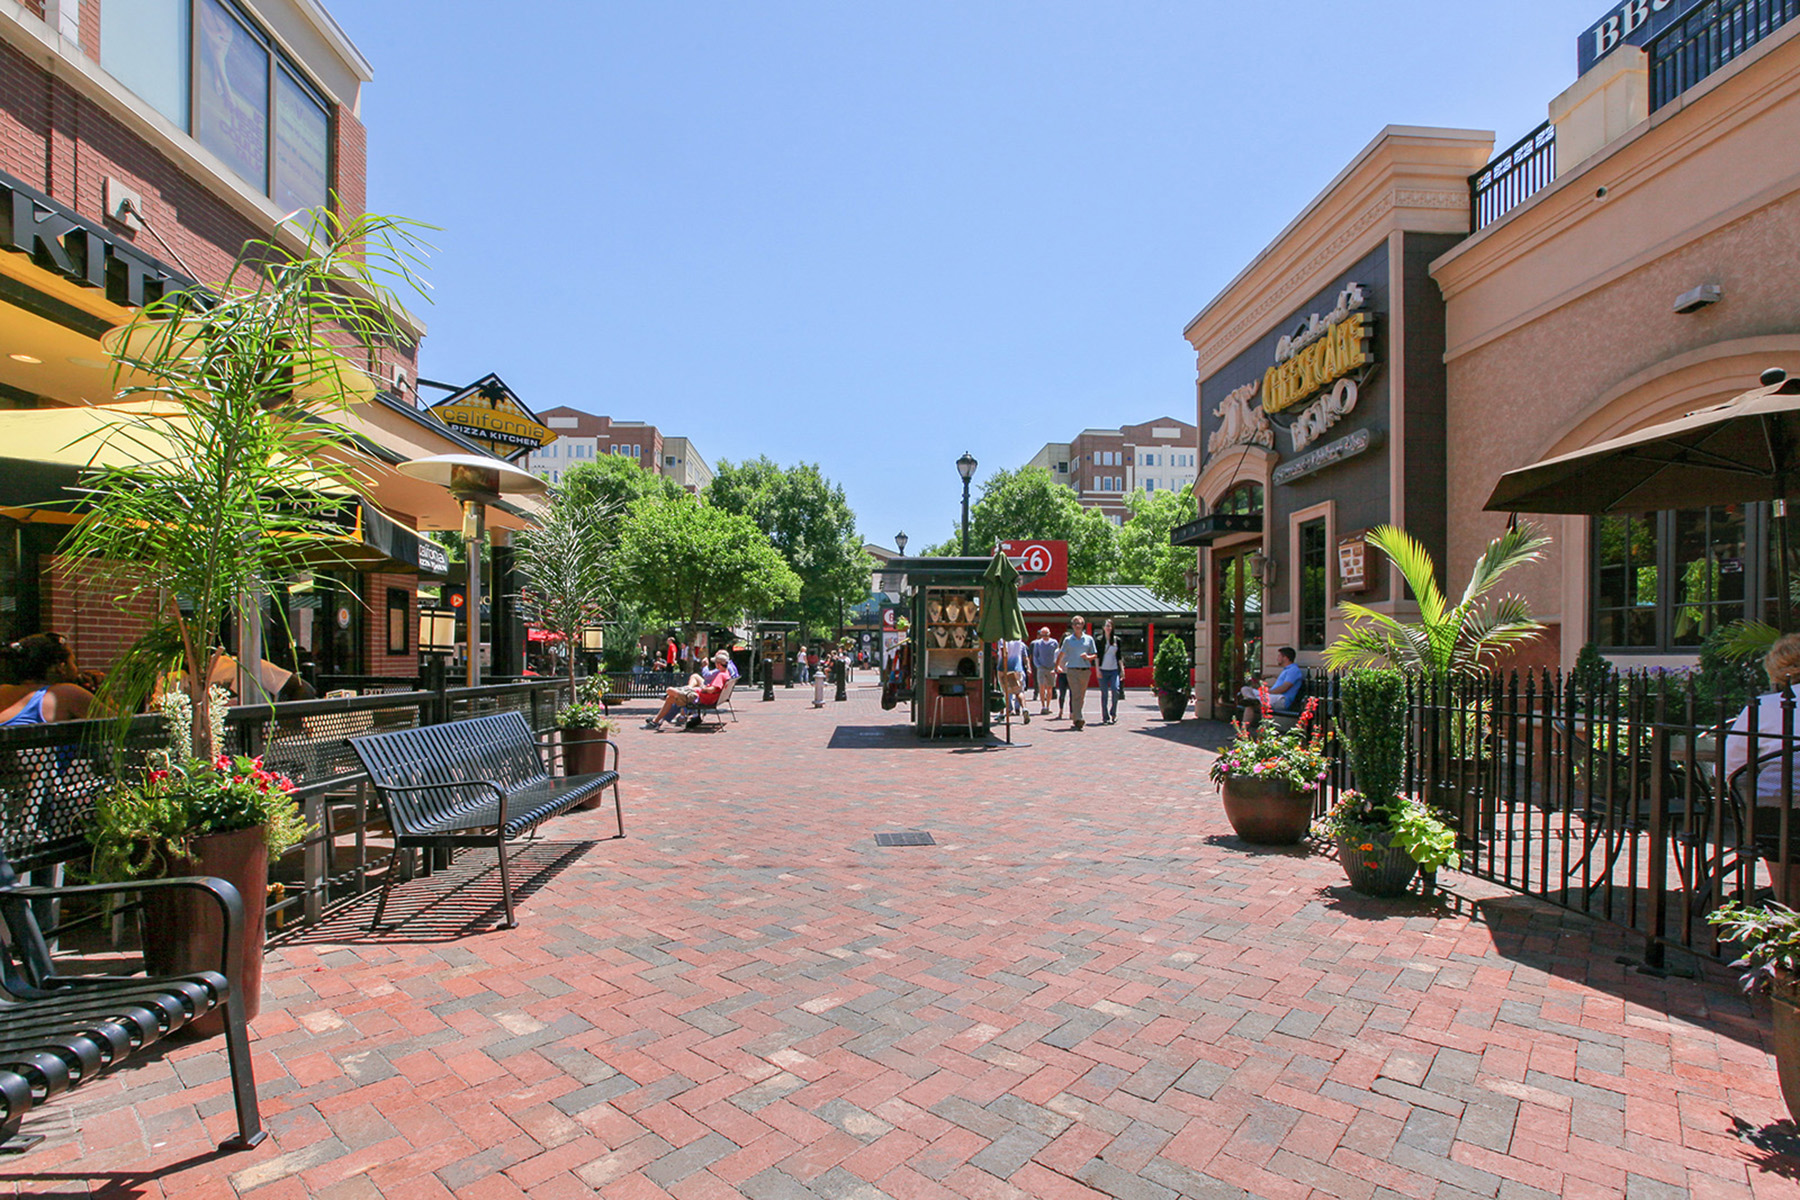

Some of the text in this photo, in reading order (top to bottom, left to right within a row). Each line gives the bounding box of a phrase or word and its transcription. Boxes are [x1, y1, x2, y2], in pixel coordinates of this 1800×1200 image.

[1261, 312, 1373, 414] CHEESECAKE
[442, 408, 545, 439] california
[450, 423, 540, 448] PIZZA KITCHEN
[1029, 550, 1044, 572] 6
